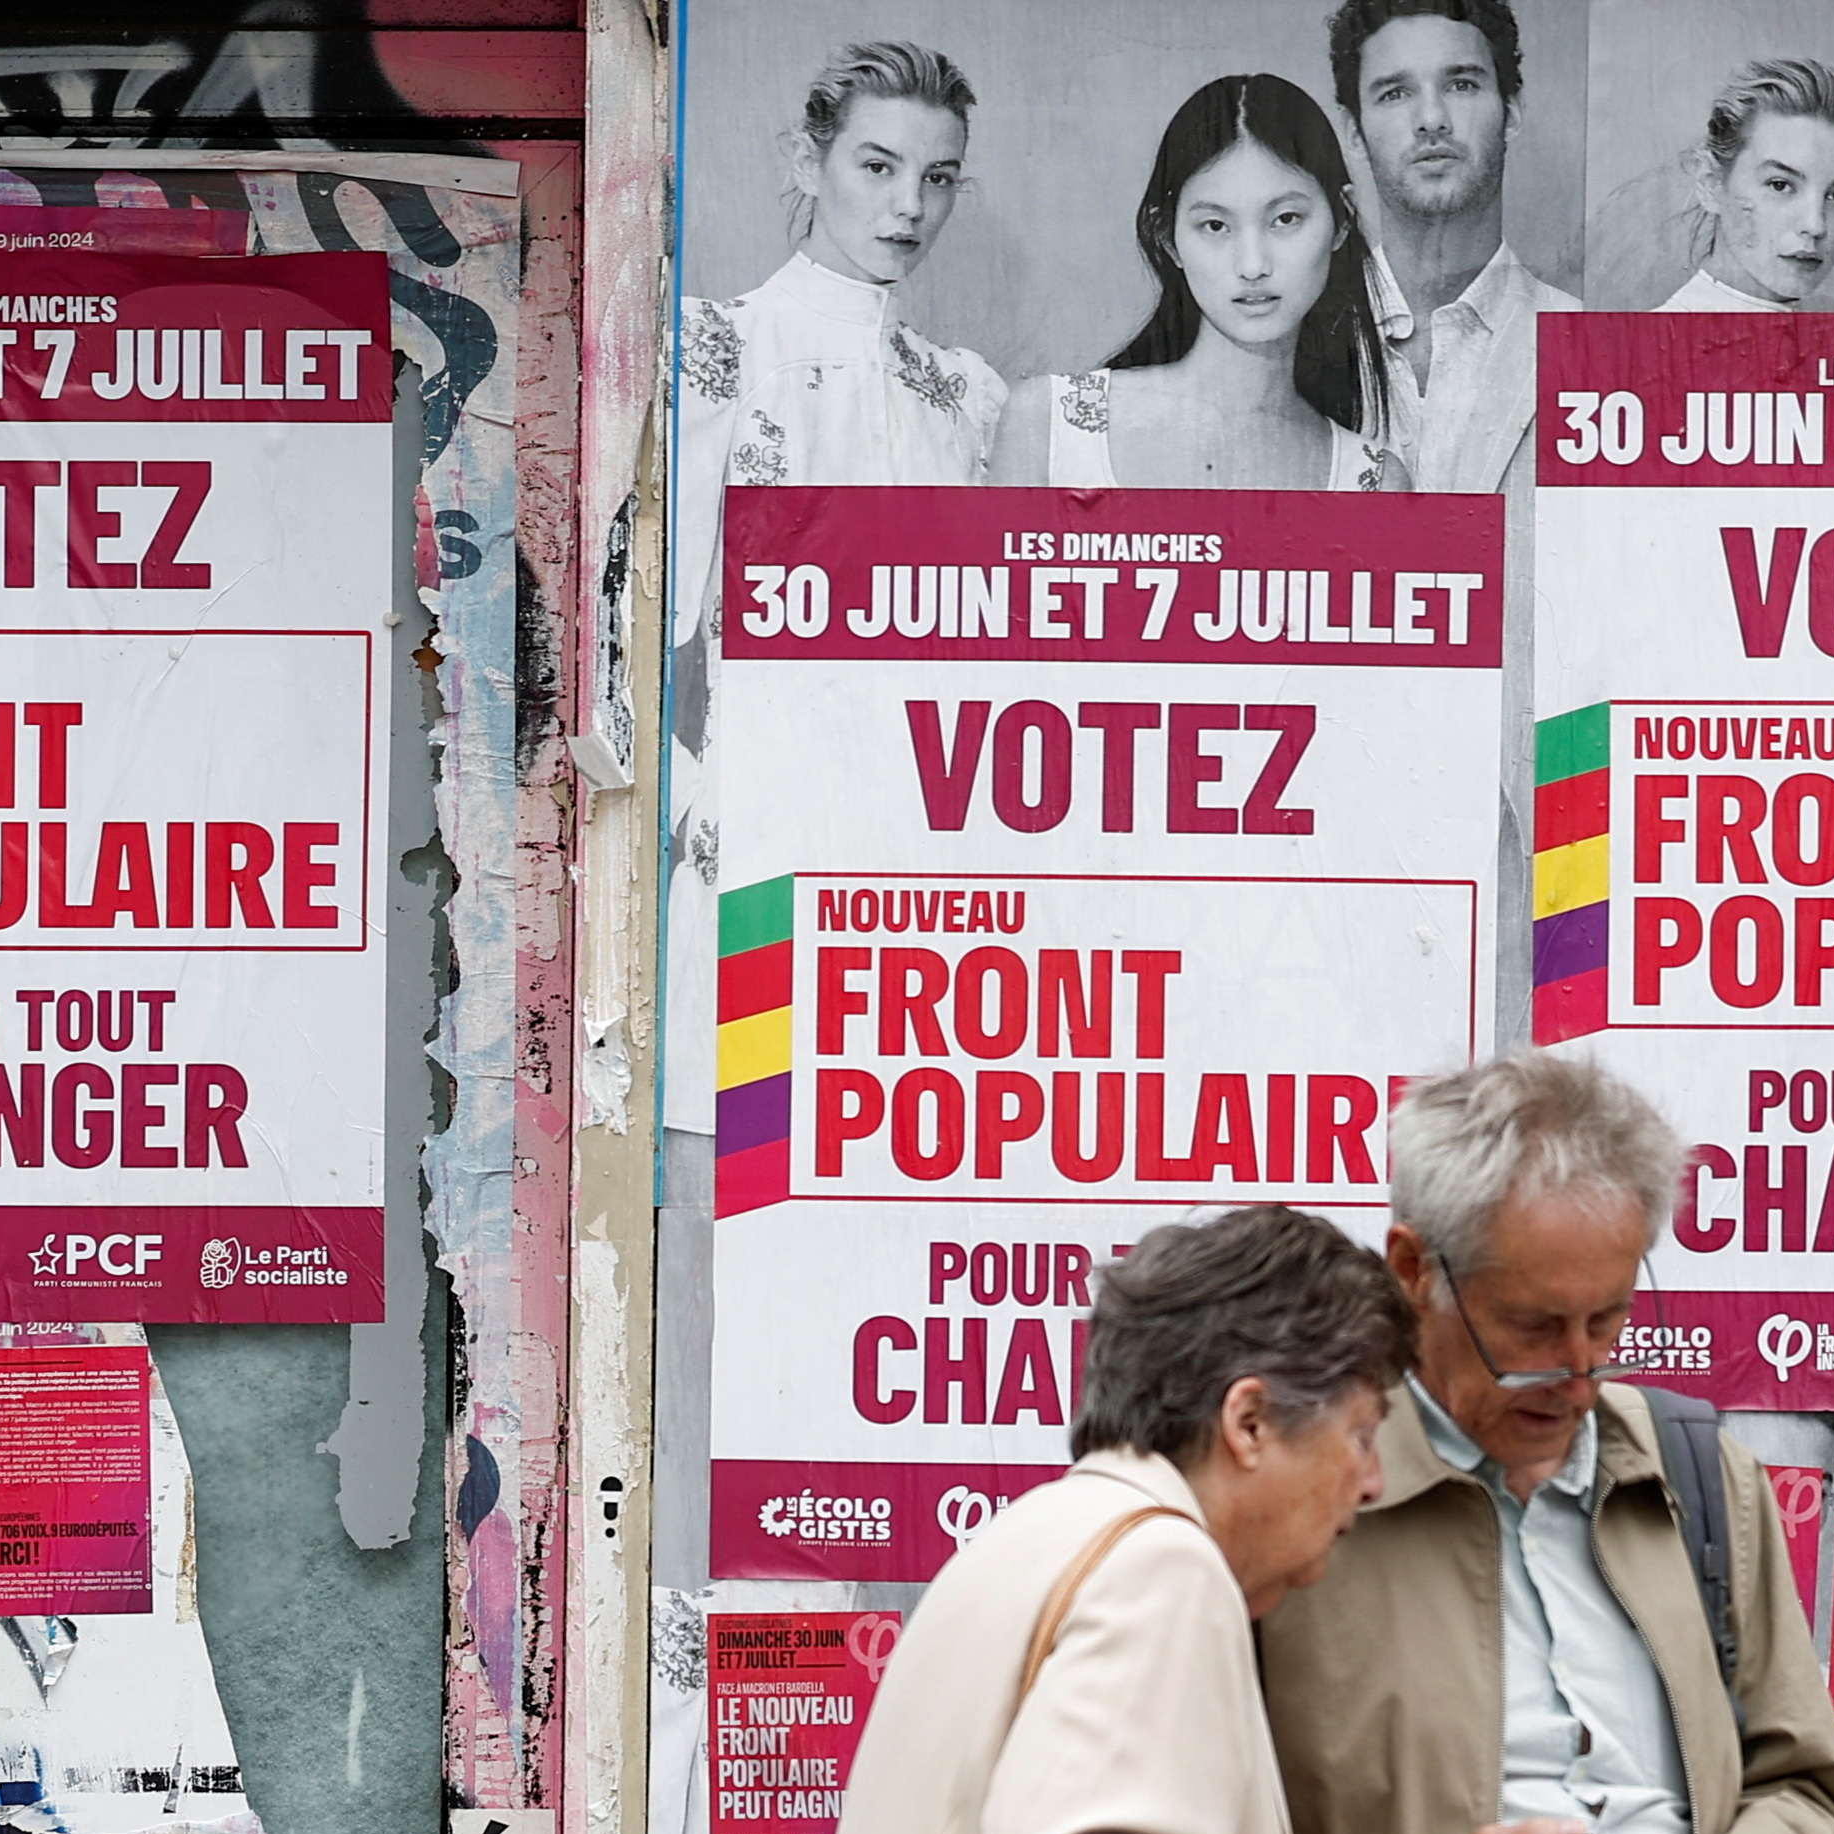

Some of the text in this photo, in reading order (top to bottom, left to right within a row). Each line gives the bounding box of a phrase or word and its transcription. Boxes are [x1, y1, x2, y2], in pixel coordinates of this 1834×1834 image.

[9, 232, 43, 251] juin
[48, 231, 95, 248] 2024
[34, 329, 76, 399] 7
[91, 329, 372, 400] JUILLET
[1556, 391, 1643, 465] 30
[1661, 392, 1824, 465] JUIN
[1003, 532, 1221, 562] LES DIMANCHES
[741, 564, 1483, 644] 30 JUIN ET 7 JUILLET
[904, 699, 1316, 835] VOTEZ
[818, 889, 1025, 934] NOUVEAU
[16, 989, 175, 1053] TOUT
[816, 946, 1181, 1060] FRONT
[66, 1234, 163, 1276] PCF
[244, 1264, 348, 1287] socialiste
[245, 1246, 327, 1267] Le Parti
[929, 1241, 1092, 1306] POUR
